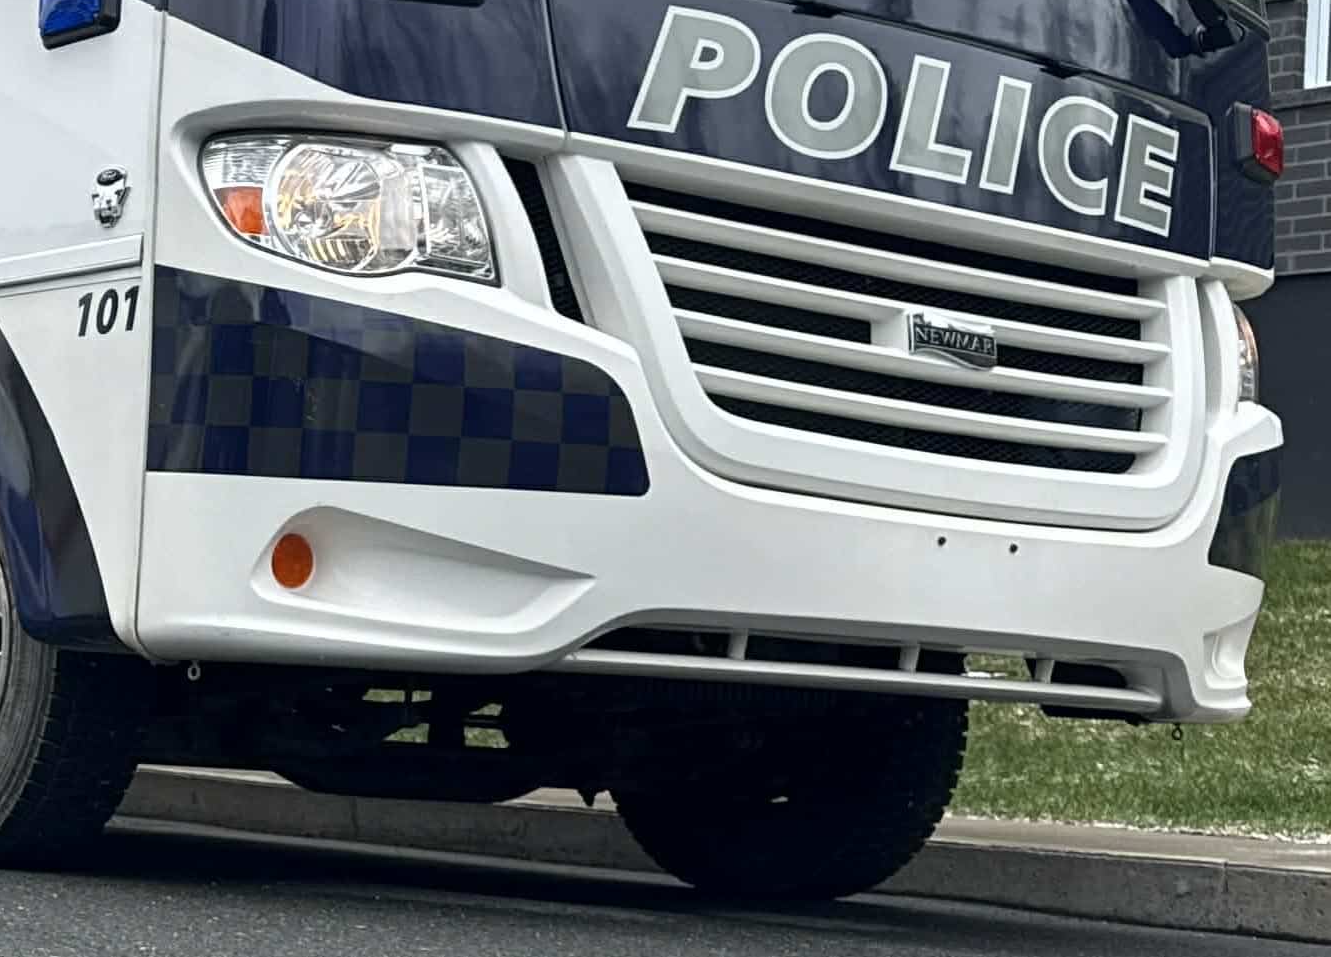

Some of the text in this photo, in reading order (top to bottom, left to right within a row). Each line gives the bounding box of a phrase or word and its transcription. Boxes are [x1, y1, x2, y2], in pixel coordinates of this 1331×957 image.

[626, 5, 1181, 238] POLICE
[78, 285, 140, 338] 101
[915, 326, 993, 353] NEWMAR
